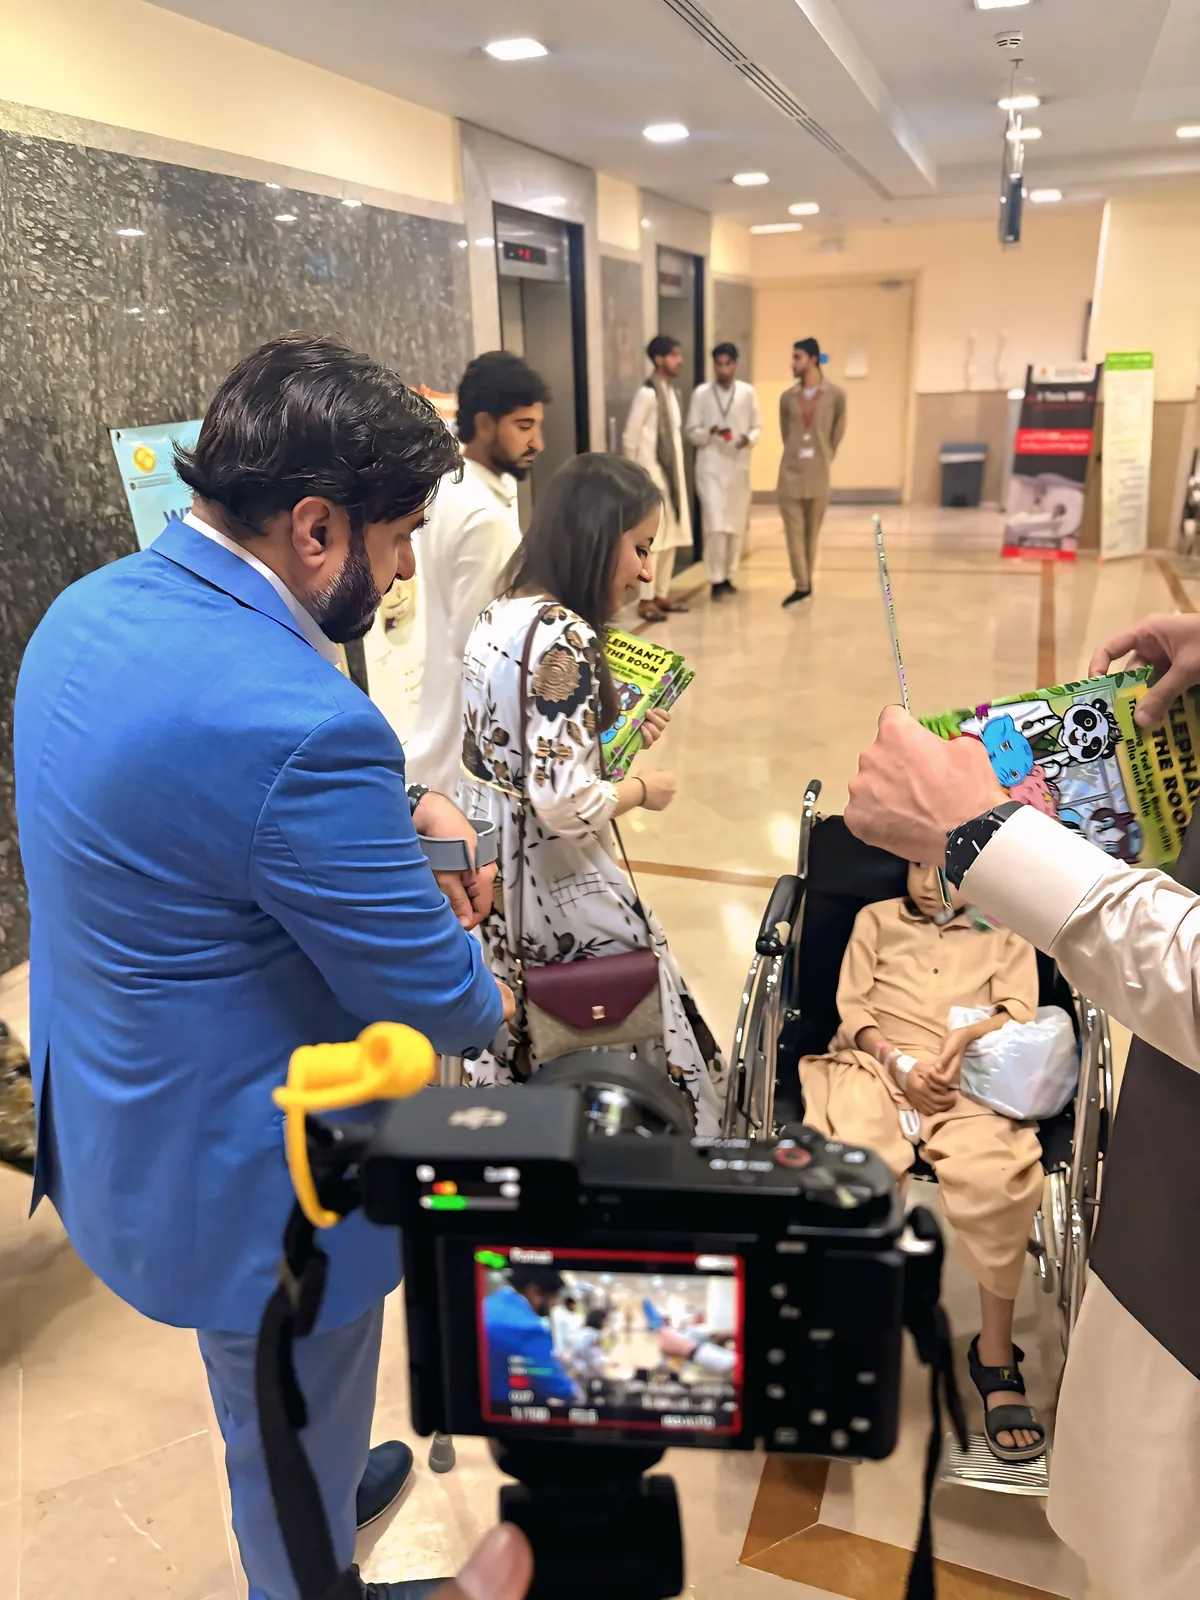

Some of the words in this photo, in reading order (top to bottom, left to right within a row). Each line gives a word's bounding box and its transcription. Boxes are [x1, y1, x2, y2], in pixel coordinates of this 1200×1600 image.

[606, 635, 666, 665] LEPHANTS
[626, 656, 659, 674] ROOM
[1126, 738, 1136, 761] Ella
[1132, 764, 1145, 786] and
[1152, 726, 1174, 772] THE
